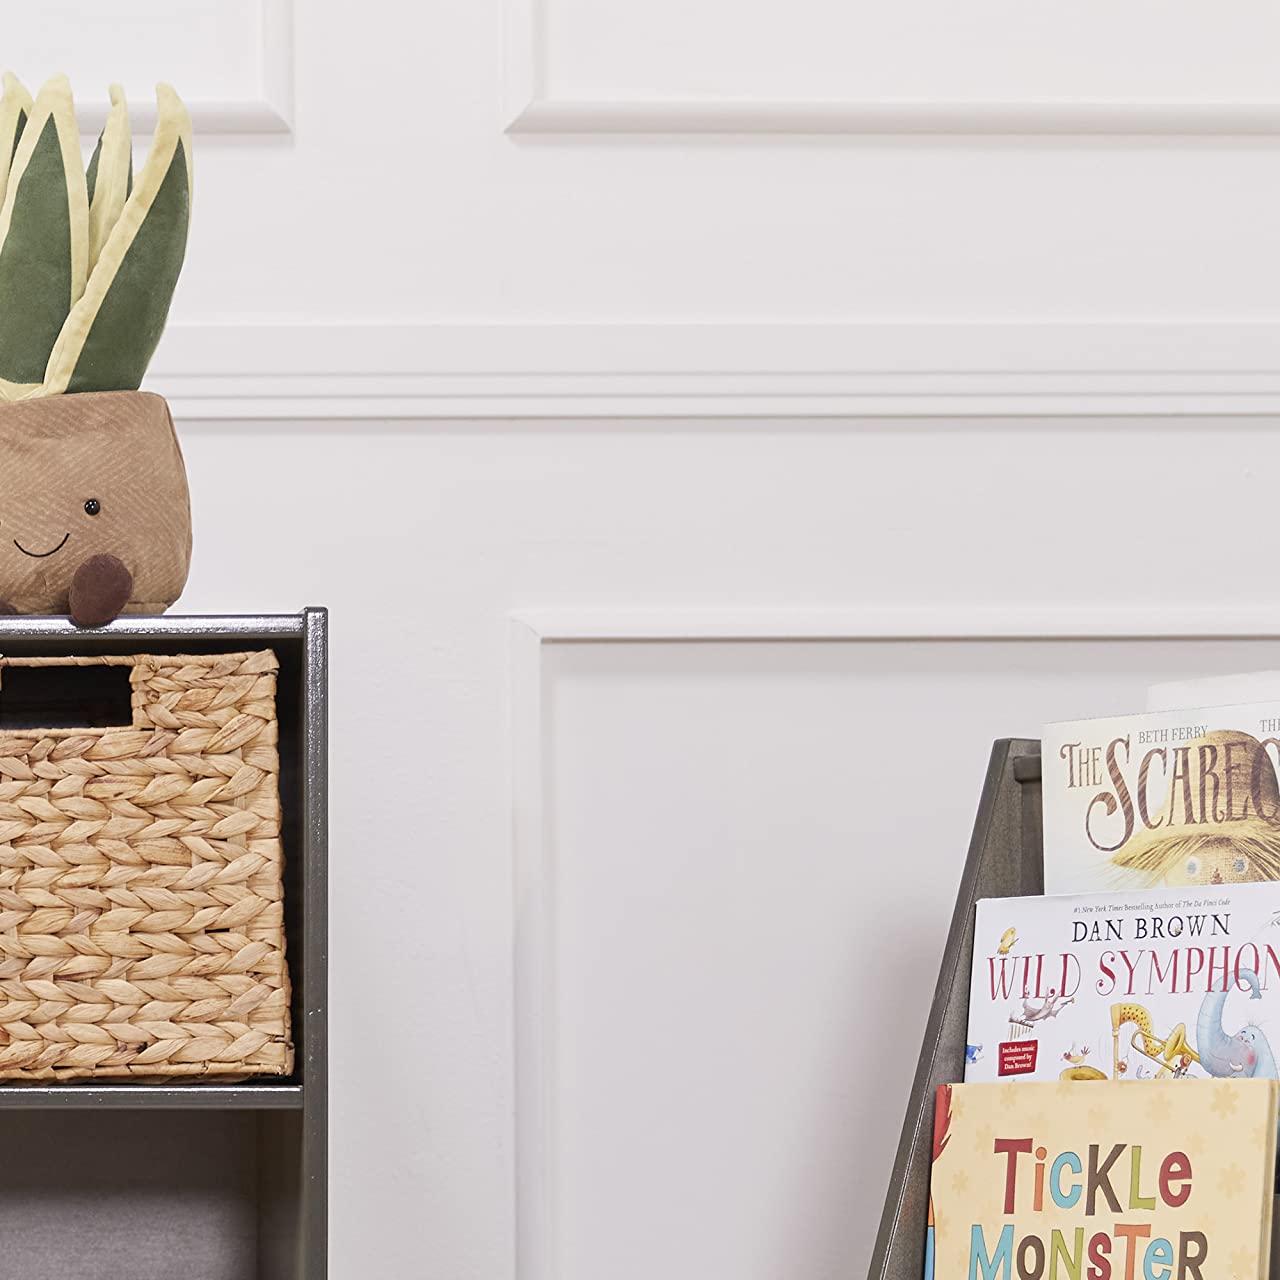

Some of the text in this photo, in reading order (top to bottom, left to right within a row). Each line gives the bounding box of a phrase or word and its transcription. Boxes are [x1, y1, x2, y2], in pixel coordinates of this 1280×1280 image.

[1139, 725, 1208, 744] BETH FERRY
[1095, 905, 1107, 913] York
[1125, 903, 1153, 912] Bestselling
[1072, 914, 1231, 942] DAN BROWN
[987, 953, 1080, 1000] WILD
